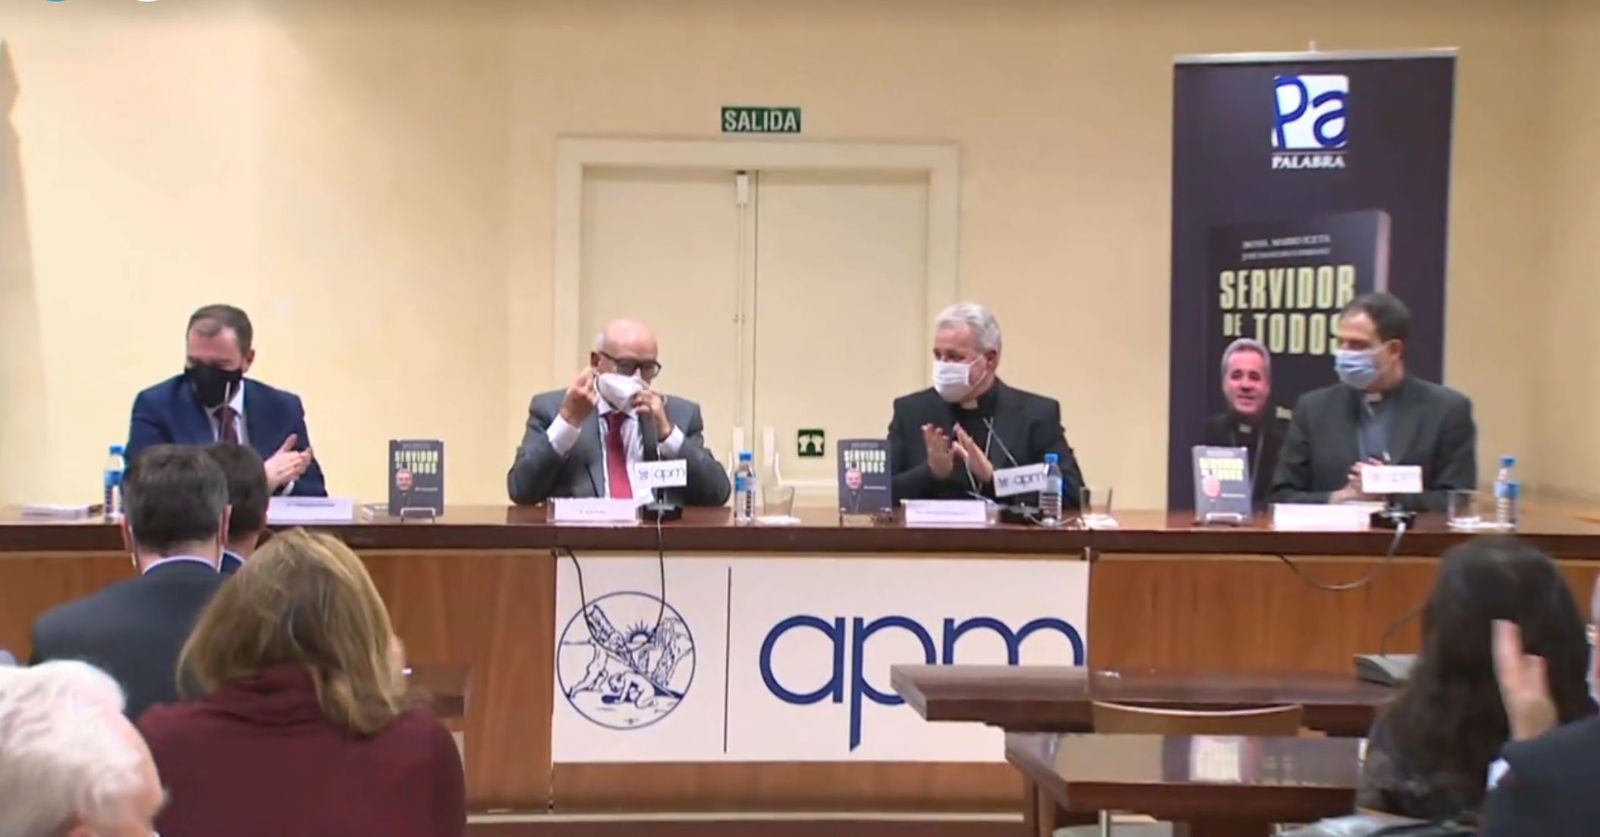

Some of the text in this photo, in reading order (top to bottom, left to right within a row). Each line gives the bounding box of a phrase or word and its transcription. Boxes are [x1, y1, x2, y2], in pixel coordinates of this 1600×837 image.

[724, 109, 798, 131] SALIDA
[1273, 75, 1348, 148] Pa
[1271, 155, 1346, 169] PALABRA
[1219, 264, 1356, 310] SERVIDOR
[1223, 314, 1242, 336] DE
[655, 467, 685, 482] apm
[1014, 472, 1045, 487] apm
[759, 615, 1085, 751] apm
